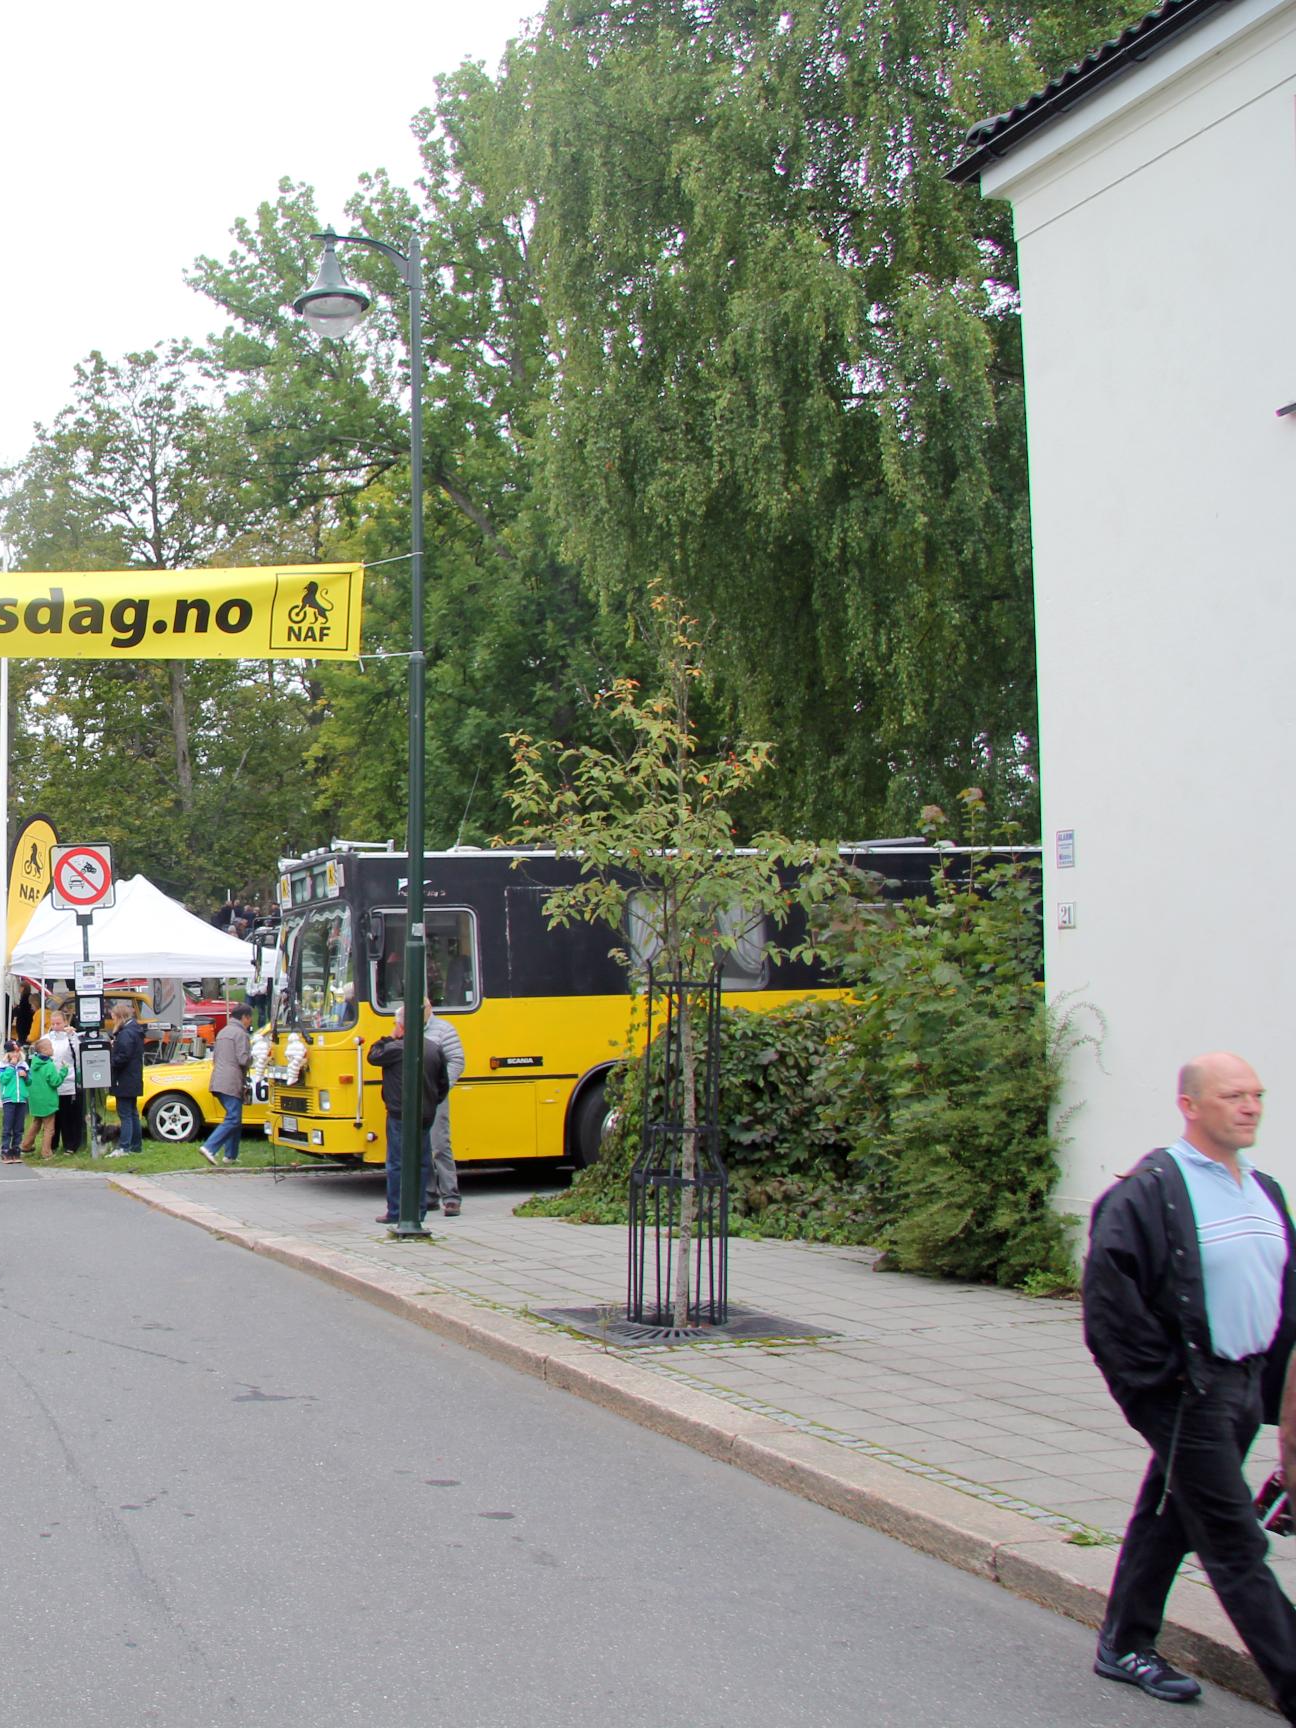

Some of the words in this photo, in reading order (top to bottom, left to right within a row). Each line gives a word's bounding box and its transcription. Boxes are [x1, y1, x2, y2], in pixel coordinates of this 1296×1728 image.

[287, 626, 331, 642] NAF
[1060, 906, 1071, 924] 21
[507, 1057, 534, 1065] SCANIA
[255, 1081, 269, 1102] 6
